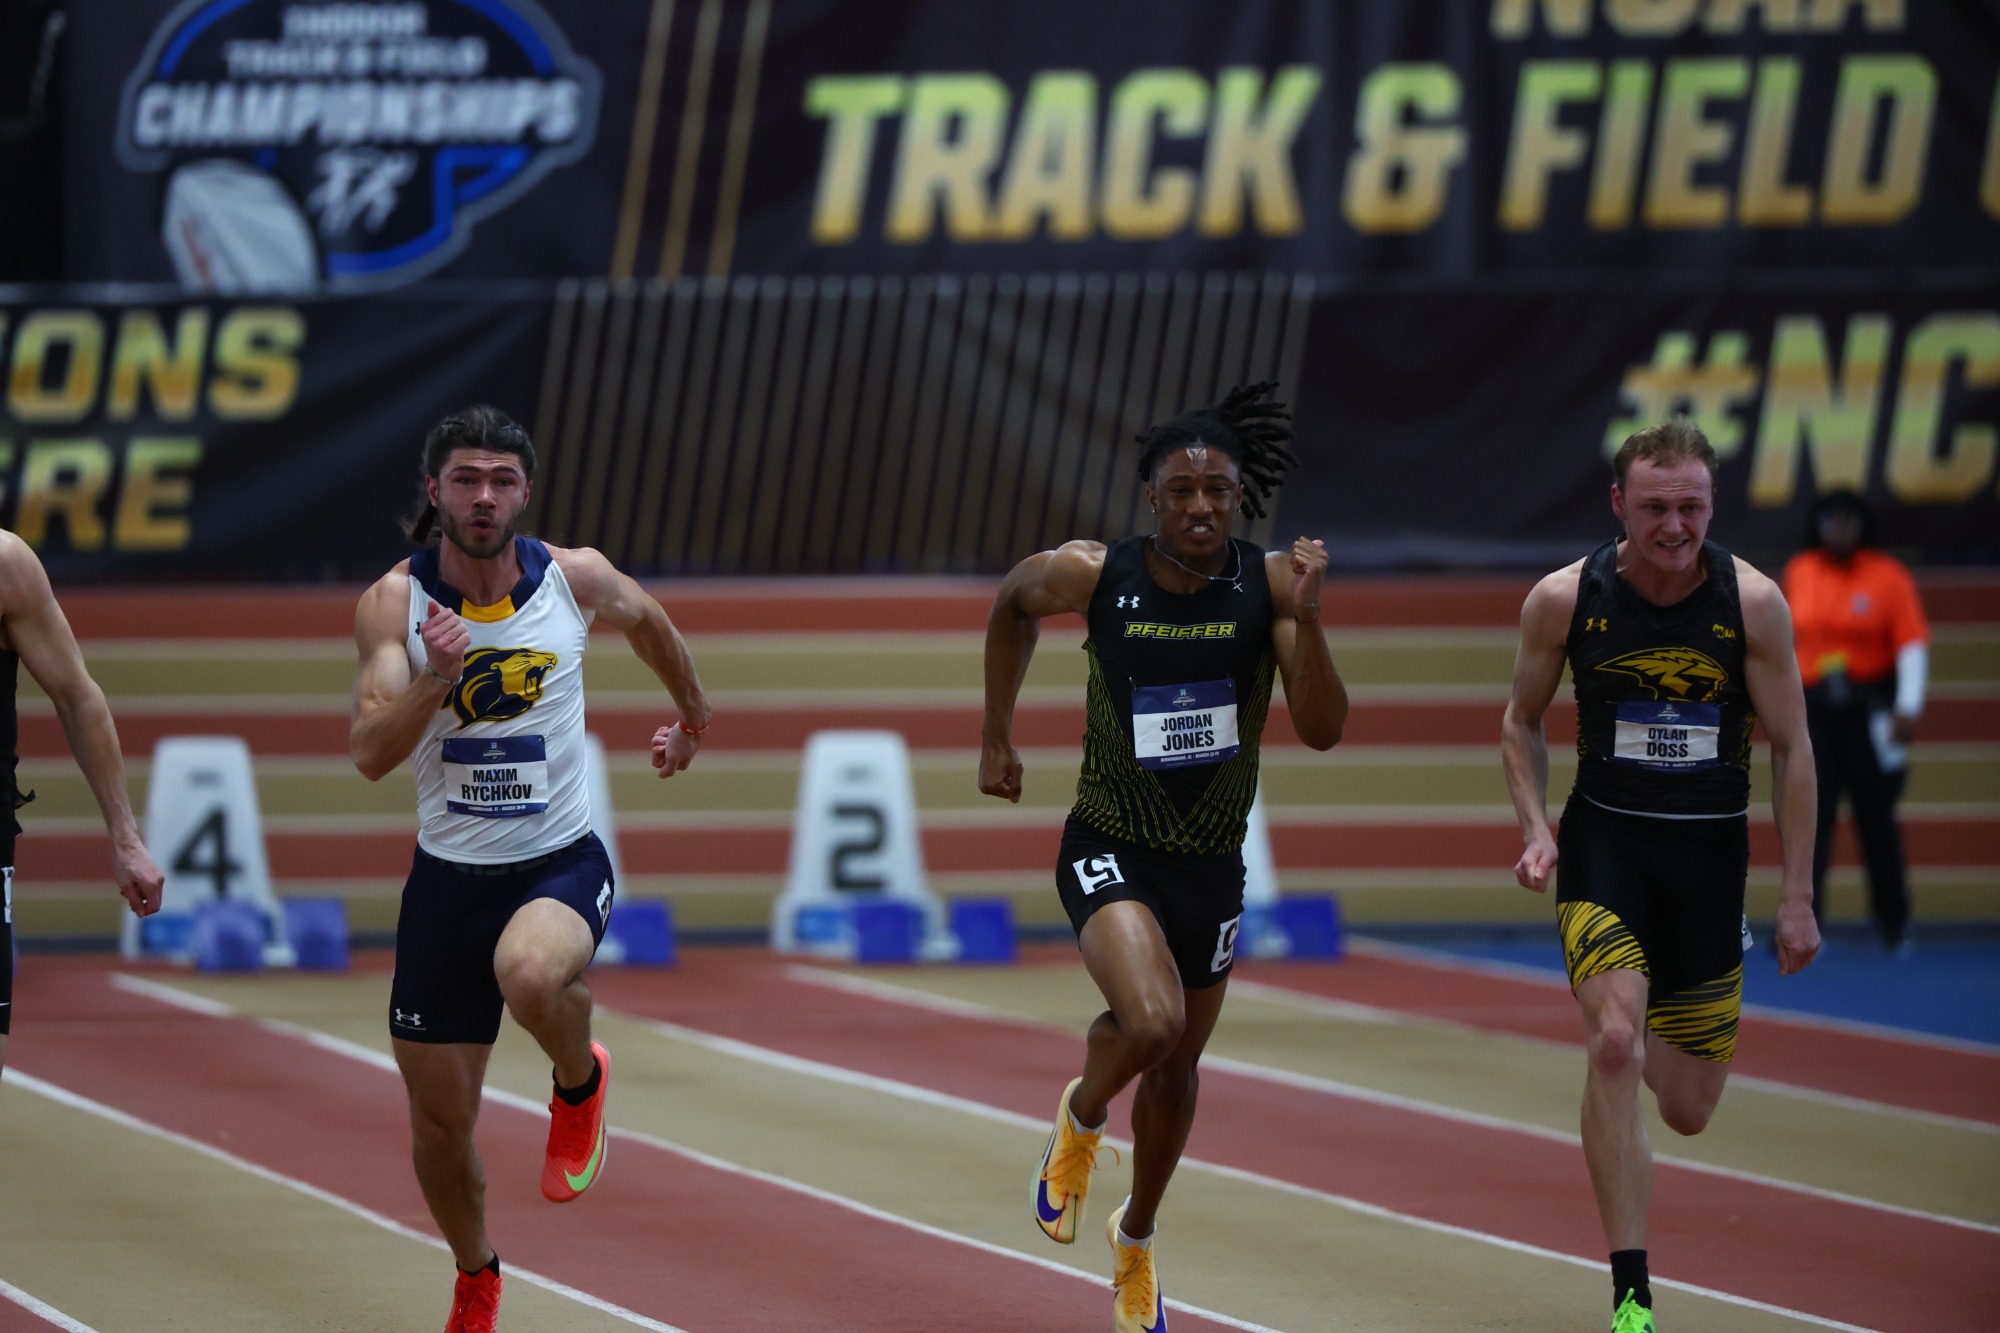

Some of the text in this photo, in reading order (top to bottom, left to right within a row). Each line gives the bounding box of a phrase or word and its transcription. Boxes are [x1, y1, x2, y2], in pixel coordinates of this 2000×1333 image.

[225, 38, 338, 77] TRACK
[378, 37, 488, 77] FIELD
[132, 77, 581, 147] CHAMPIONSHIPS
[804, 65, 1322, 243] TRACK
[1341, 61, 1467, 235] &
[1498, 52, 1940, 232] FIELD
[0, 307, 306, 423] ONS
[0, 436, 204, 550] RE
[1124, 622, 1236, 640] PFEIFFER
[1161, 713, 1212, 732] JORDAN
[1648, 727, 1688, 741] DYLAN
[1162, 730, 1215, 752] JONES
[1647, 742, 1689, 758] DOSS
[472, 768, 518, 783] MAXIM
[461, 784, 532, 802] RYCHKOV
[172, 804, 243, 898] 4
[829, 802, 887, 891] 2
